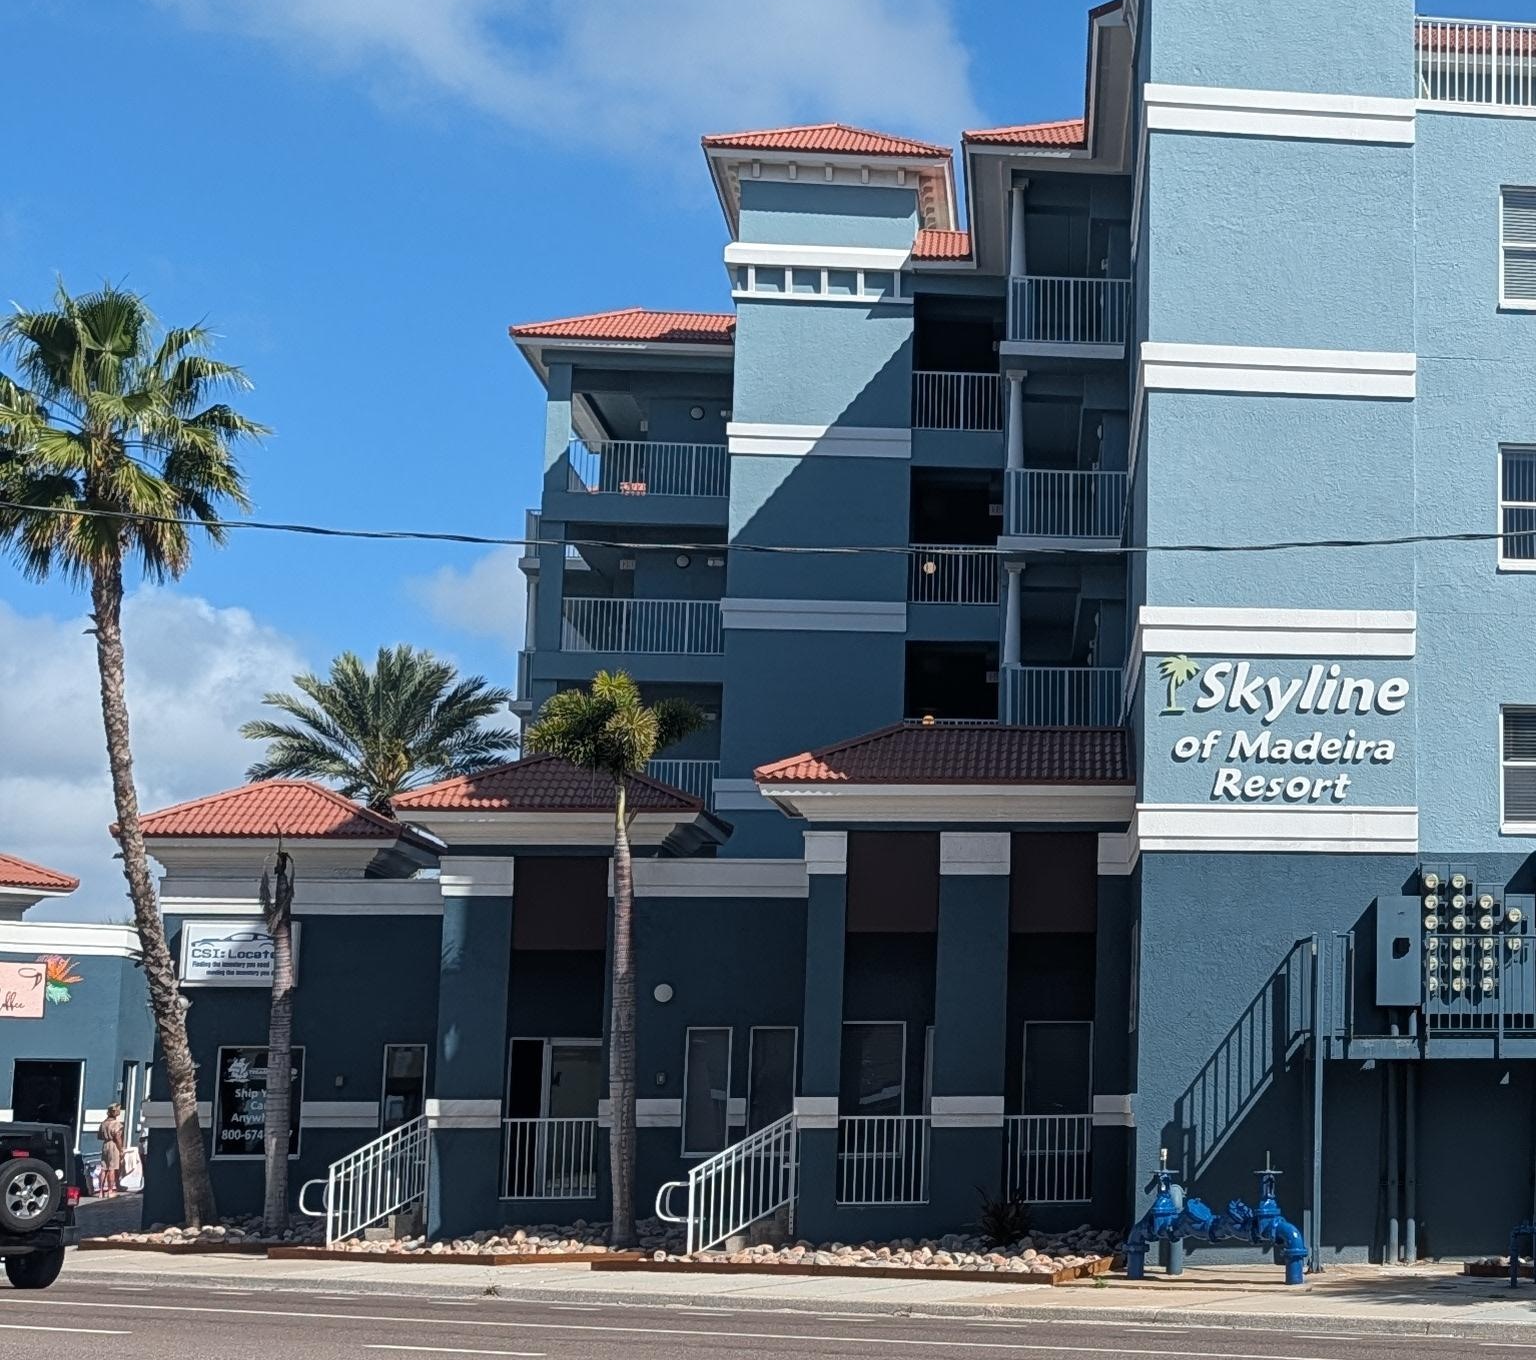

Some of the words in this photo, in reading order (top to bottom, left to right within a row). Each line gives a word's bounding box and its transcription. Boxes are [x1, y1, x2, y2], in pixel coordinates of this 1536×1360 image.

[1197, 661, 1410, 722] Skyline
[1175, 730, 1222, 758] of
[1228, 729, 1396, 761] Madeira
[1213, 768, 1352, 799] Resort
[234, 1088, 258, 1099] Ship
[250, 1101, 264, 1110] Ca
